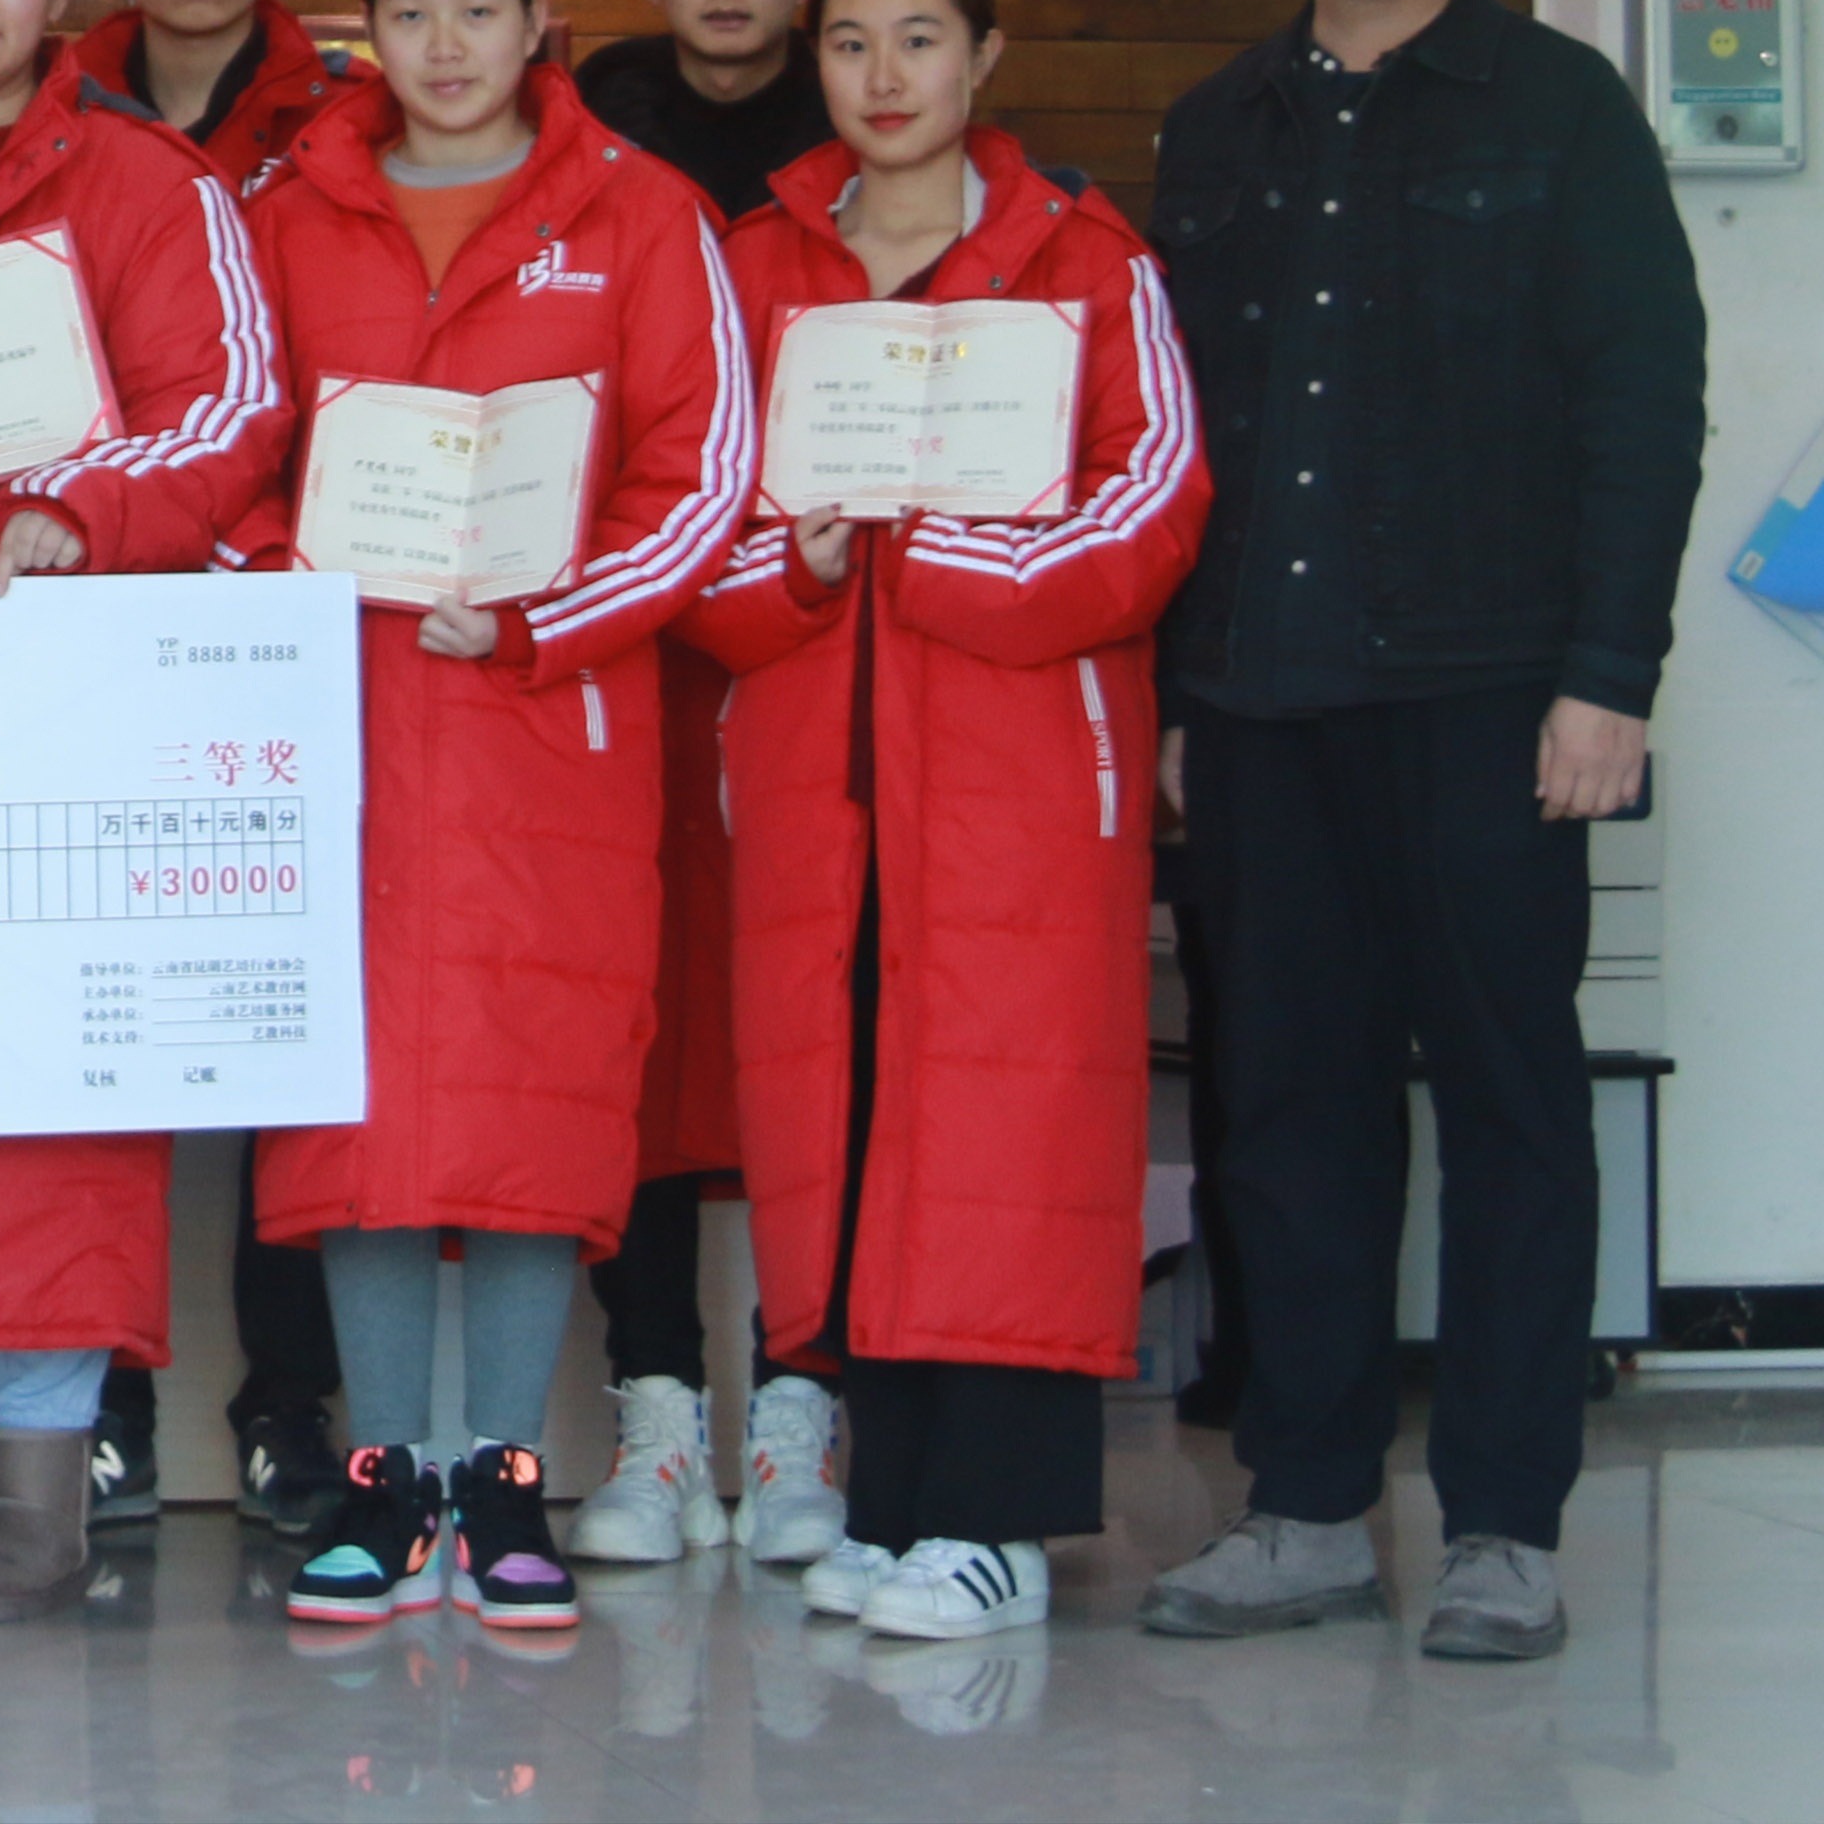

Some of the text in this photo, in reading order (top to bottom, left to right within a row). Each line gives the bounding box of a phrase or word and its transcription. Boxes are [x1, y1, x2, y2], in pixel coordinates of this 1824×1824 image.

[156, 636, 179, 649] YP
[187, 644, 298, 663] 8888 8888
[148, 738, 300, 787] 三等奖
[129, 864, 297, 897] ¥30000
